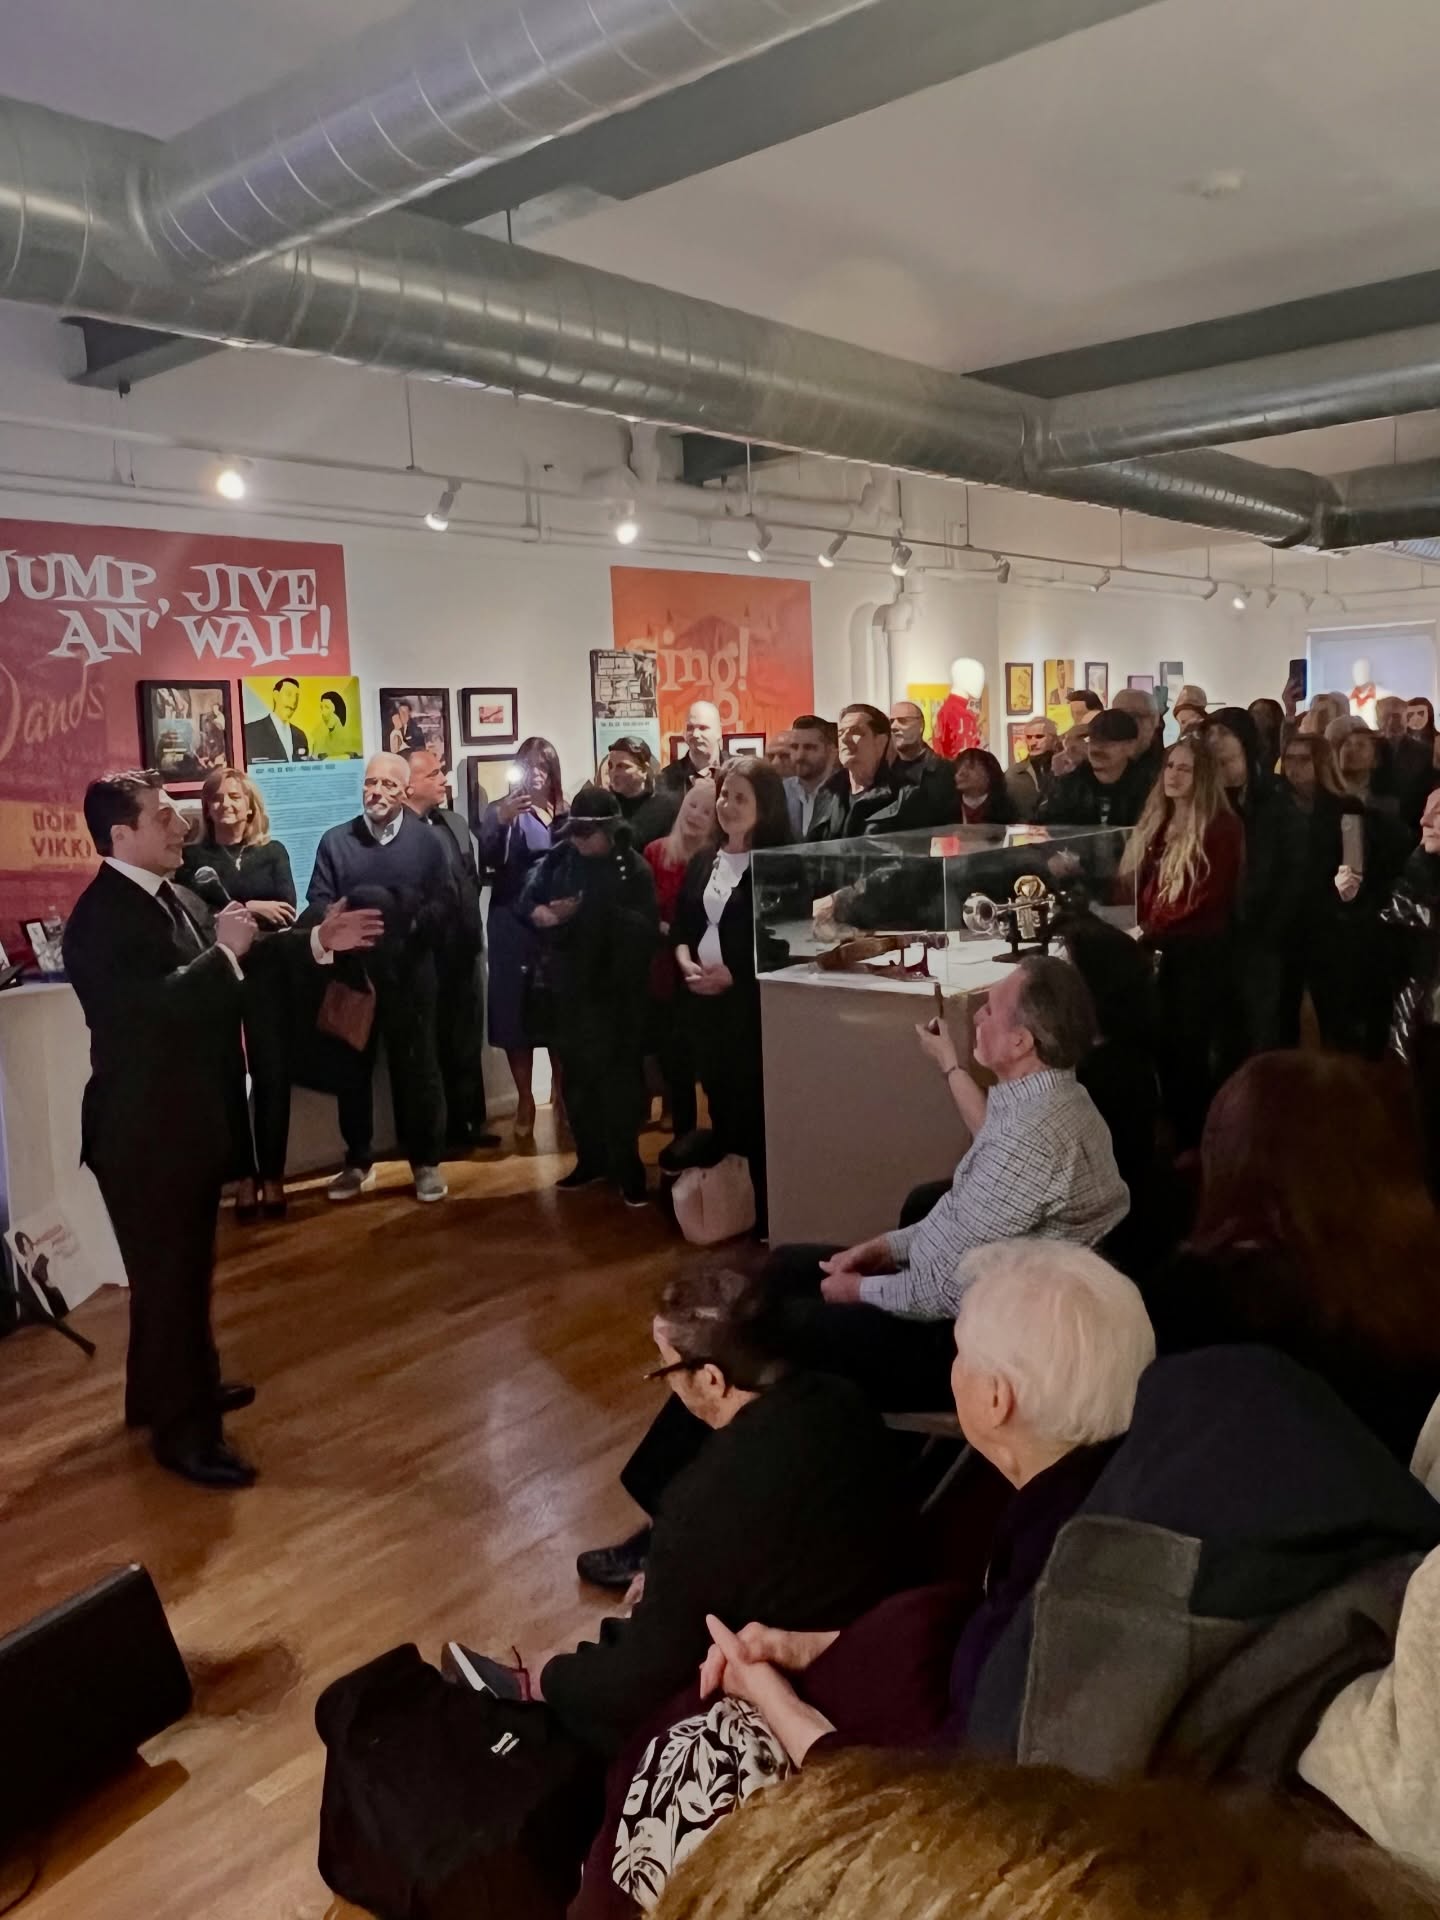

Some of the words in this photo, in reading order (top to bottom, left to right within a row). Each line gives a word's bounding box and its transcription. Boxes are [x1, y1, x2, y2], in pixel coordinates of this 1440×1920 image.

[182, 563, 316, 612] JIVE
[48, 608, 160, 665] AN'
[172, 604, 331, 667] WAIL!
[626, 625, 749, 726] ing!
